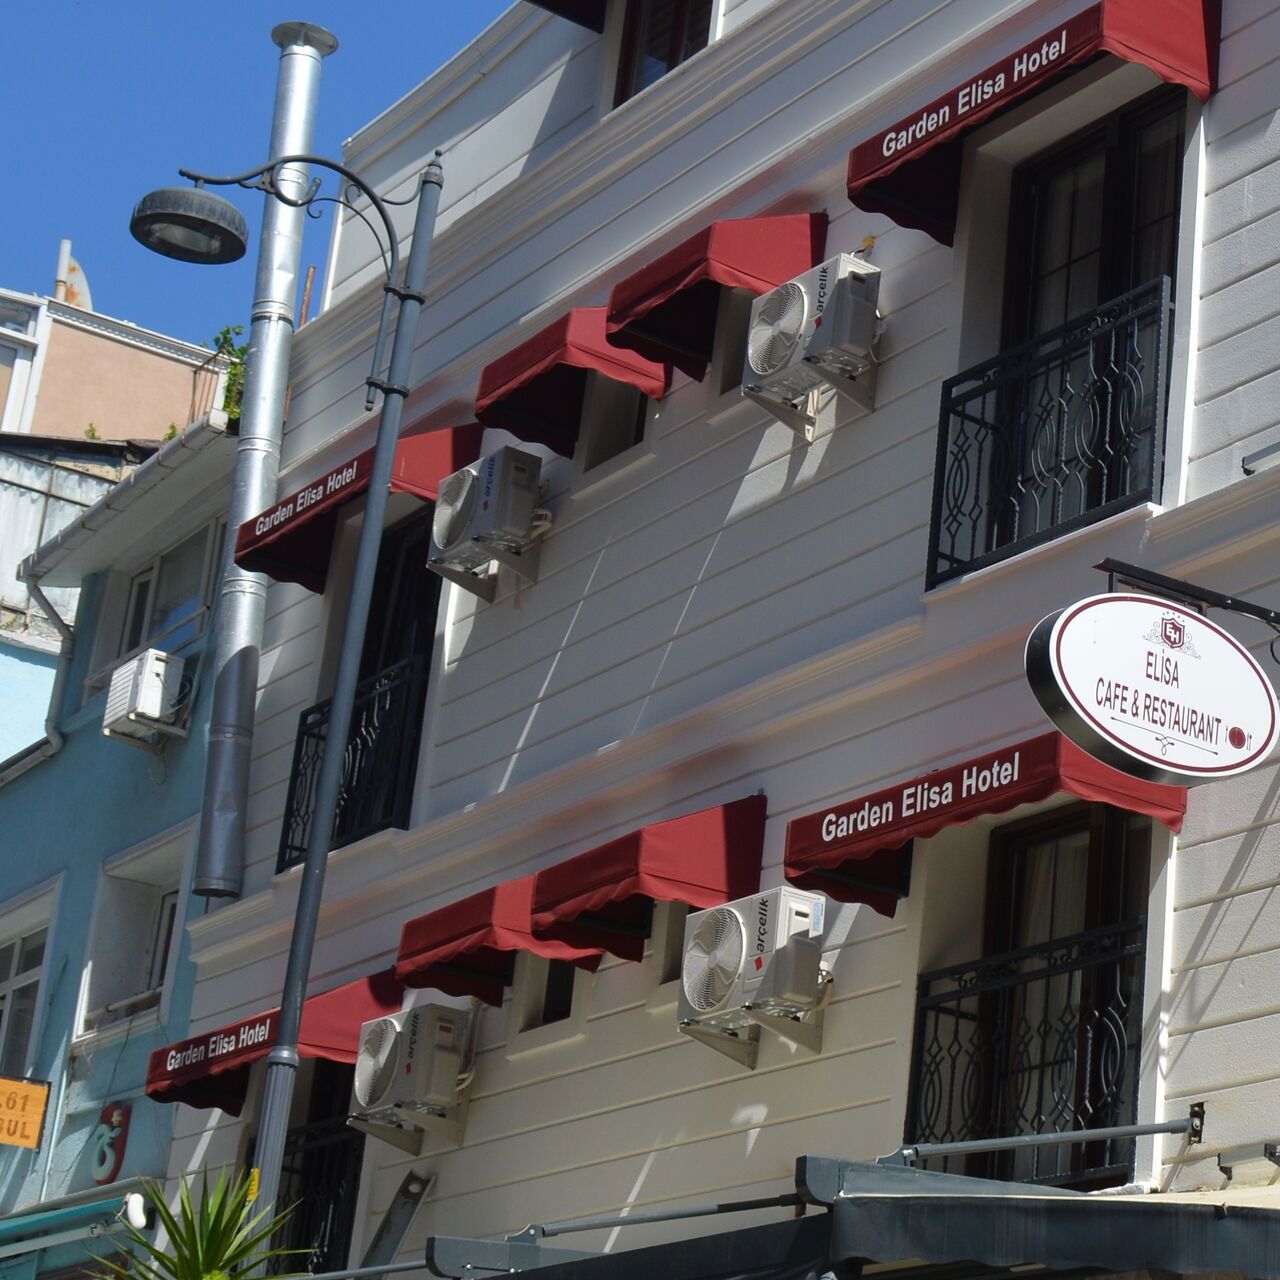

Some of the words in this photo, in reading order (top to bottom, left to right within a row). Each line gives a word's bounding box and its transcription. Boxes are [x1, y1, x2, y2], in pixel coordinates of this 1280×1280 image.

[882, 105, 949, 157] Garden
[957, 72, 1005, 115] Elisa
[1013, 30, 1067, 82] Hotel
[816, 266, 829, 312] arçelik
[255, 503, 293, 536] Garden
[296, 485, 323, 512] Elisa
[326, 461, 357, 495] Hotel
[1145, 648, 1180, 688] ELİSA
[1095, 677, 1129, 714] CAFE
[1131, 690, 1140, 718] &
[1142, 693, 1222, 746] RESTAURANT
[821, 800, 894, 842] Garden
[901, 781, 953, 817] Elisa
[961, 751, 1020, 798] Hotel
[755, 898, 769, 953] arçelik
[166, 1044, 205, 1071] Garden
[208, 1033, 236, 1058] Elisa
[238, 1018, 271, 1048] Hotel
